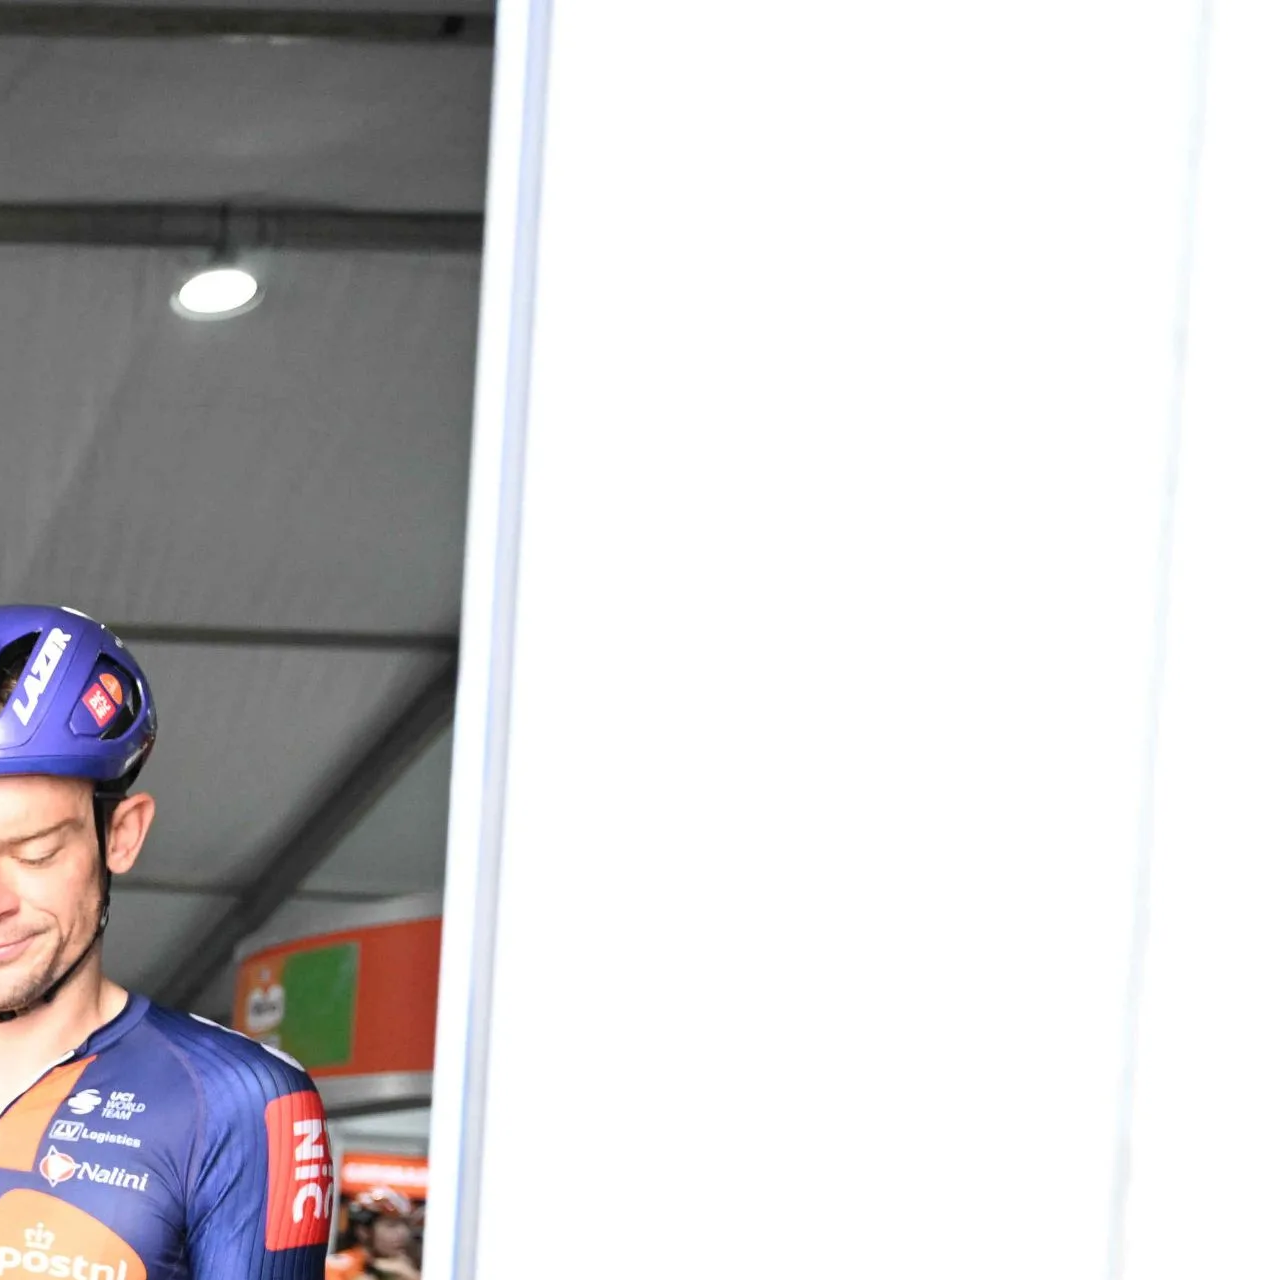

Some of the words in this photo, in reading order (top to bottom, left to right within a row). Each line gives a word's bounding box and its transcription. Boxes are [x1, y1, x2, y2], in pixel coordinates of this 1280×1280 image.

[12, 627, 72, 726] LAZER
[111, 1091, 135, 1102] UCI
[102, 1108, 132, 1120] TEAM
[106, 1100, 145, 1113] WORLD
[82, 1127, 141, 1148] Logistics
[77, 1161, 149, 1191] Nalini
